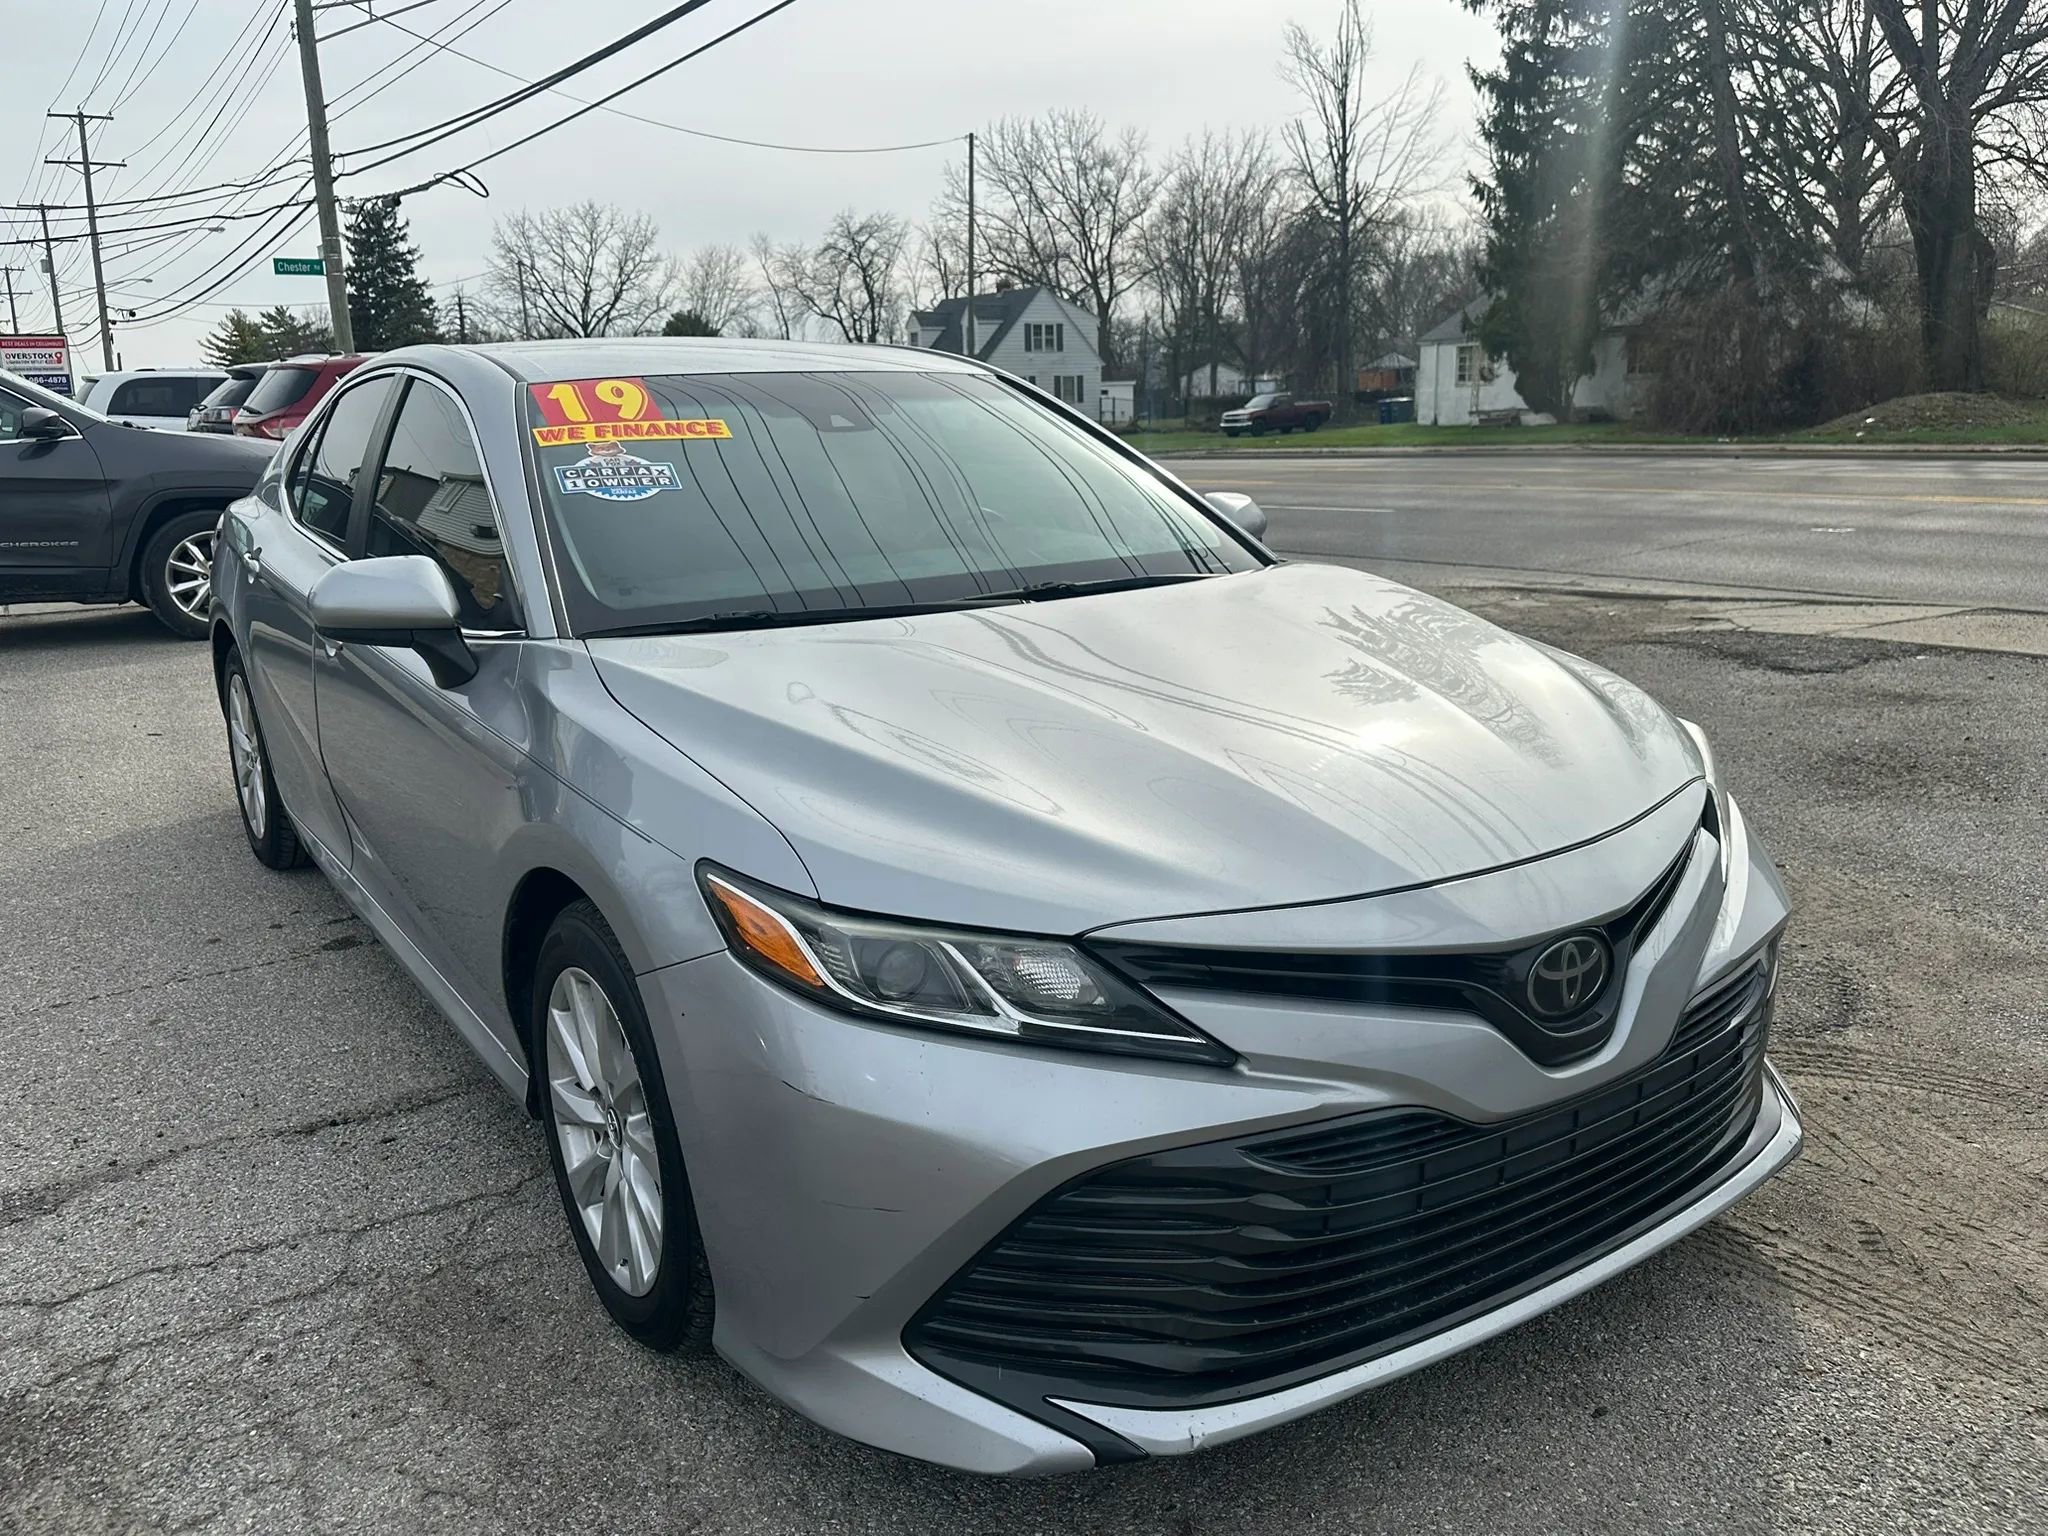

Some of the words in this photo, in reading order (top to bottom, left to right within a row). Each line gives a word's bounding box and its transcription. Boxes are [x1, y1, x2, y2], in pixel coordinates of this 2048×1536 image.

[277, 261, 311, 272] Chester
[4, 352, 54, 360] OVERSTOCK
[547, 379, 649, 423] 19
[536, 427, 586, 442] WE
[594, 421, 726, 438] FINANCE
[565, 467, 668, 478] CARFAX
[570, 480, 580, 488] 1
[586, 477, 672, 487] OWNER
